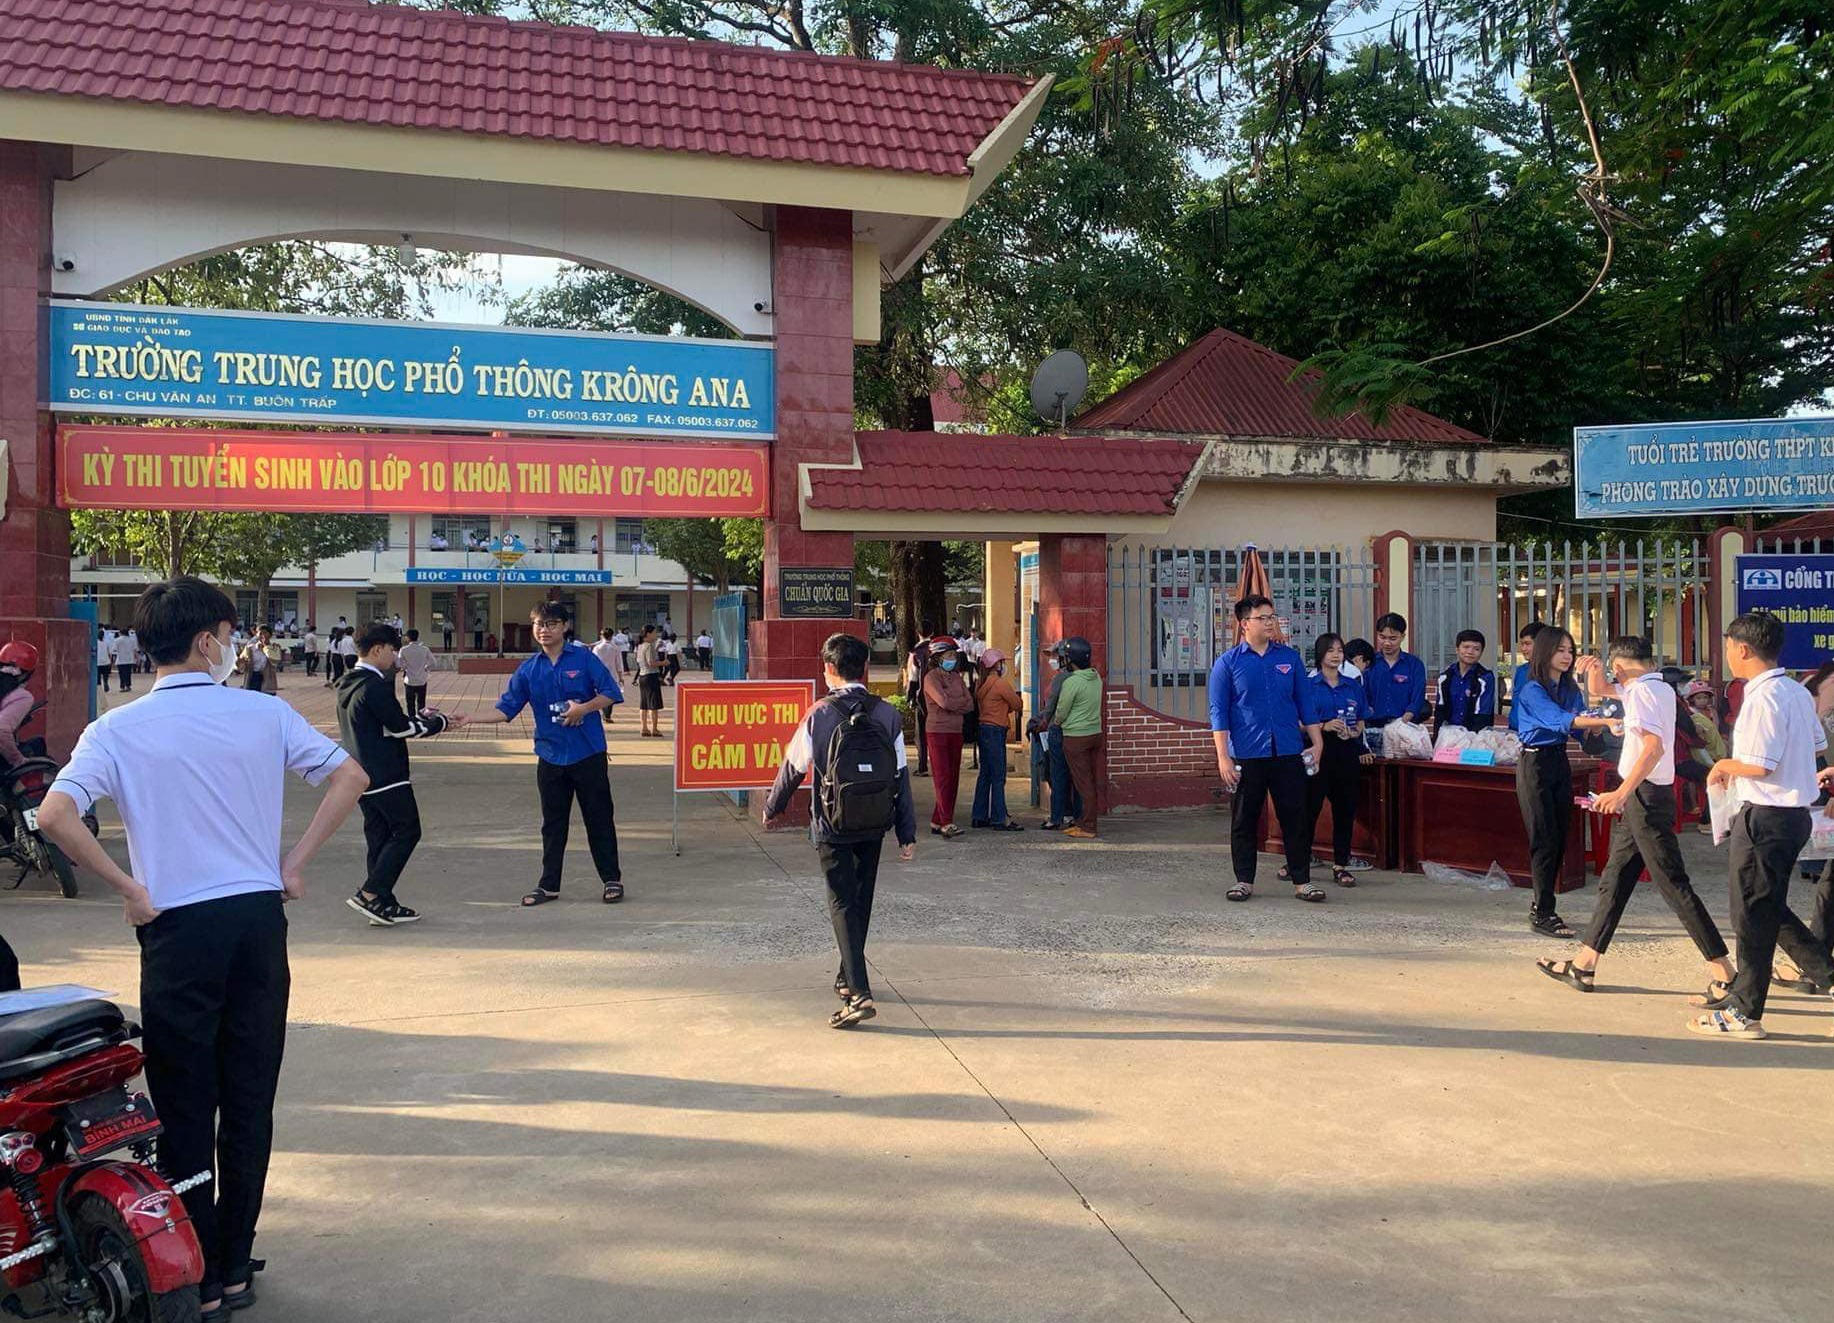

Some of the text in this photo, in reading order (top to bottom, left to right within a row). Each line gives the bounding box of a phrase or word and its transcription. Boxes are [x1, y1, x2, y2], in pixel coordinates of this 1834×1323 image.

[85, 313, 112, 322] UBND
[70, 335, 751, 410] TRƯỜNG TRUNG HỌC PHỔ THÔNG KRÔNG ANA
[69, 388, 96, 399] ĐC:
[98, 389, 114, 400] 61
[125, 390, 156, 402] CHU
[160, 391, 191, 403] VĂN
[196, 393, 217, 404] AN
[226, 395, 248, 406] TT.
[254, 394, 294, 407] BUÔN
[527, 409, 759, 429] ĐT: 05003.637.062 FAX: 05003.637.062
[1628, 433, 1665, 466] TUỔI
[1669, 435, 1700, 464] TRẺ
[1703, 434, 1771, 462] TRƯỜNG
[1774, 437, 1816, 459] THPT
[83, 443, 753, 498] KỲ THI TUYỂN SINH VÀO LỚP 10 KHÓA THI NGÀY 07-08/6/2024
[1661, 474, 1702, 501] TRÀO
[1706, 473, 1740, 499] XÂY
[1744, 475, 1792, 502] DỰNG
[416, 571, 448, 582] HỌC
[461, 571, 492, 582] HỌC
[541, 571, 570, 583] HỌC
[1785, 565, 1834, 589] CỔNG T
[785, 581, 849, 603] CHUẨN QUỐC GIA
[1788, 604, 1809, 623] bảo
[1813, 634, 1827, 648] xe
[692, 702, 800, 730] KHU VỰC THI
[691, 734, 790, 770] CẤM VÀ
